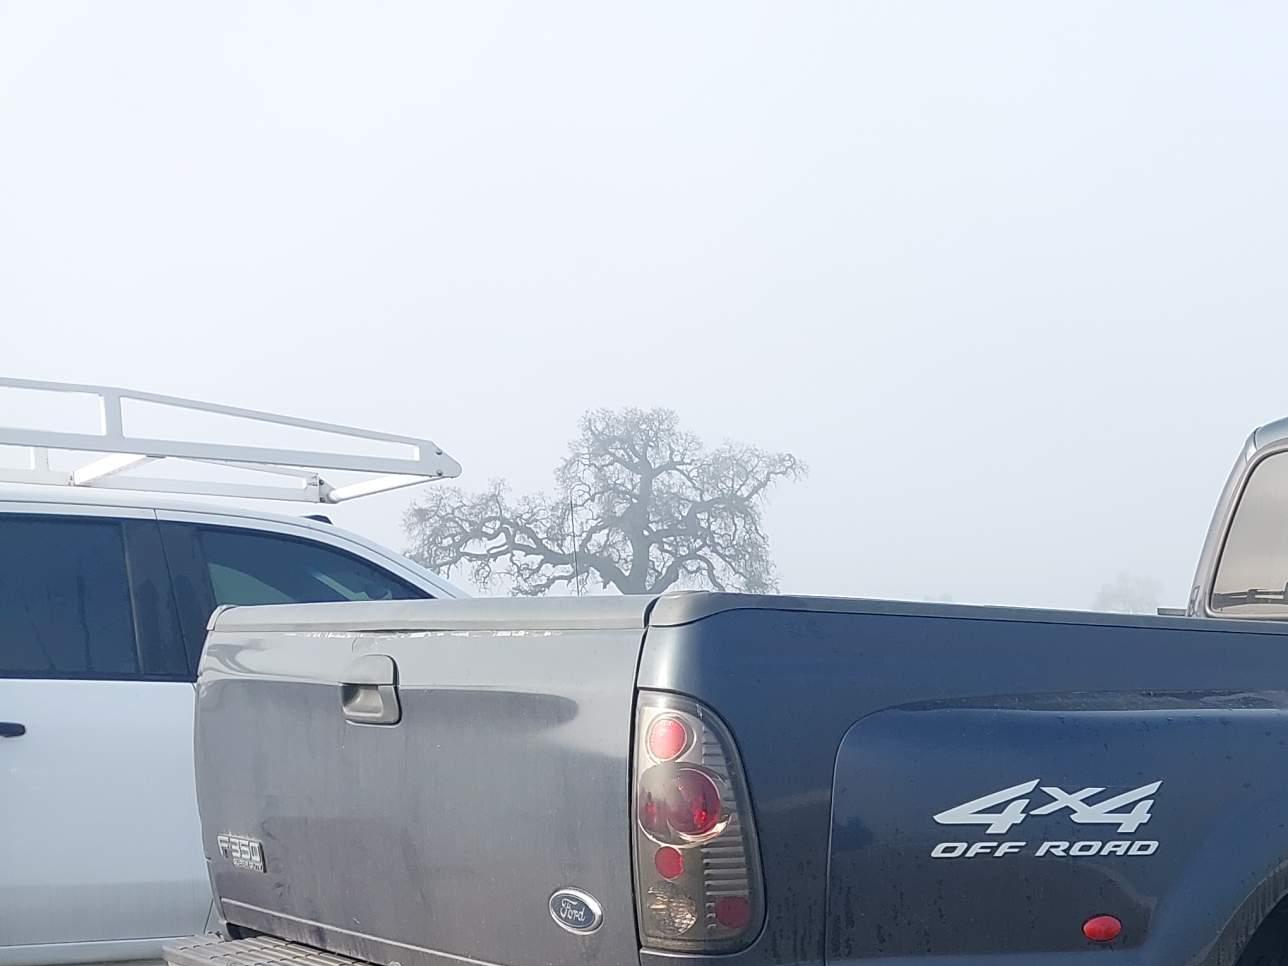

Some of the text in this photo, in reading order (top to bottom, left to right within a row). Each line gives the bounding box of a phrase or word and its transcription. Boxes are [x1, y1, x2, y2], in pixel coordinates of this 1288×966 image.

[931, 841, 1159, 858] OFF ROAD
[560, 898, 586, 922] Ford
